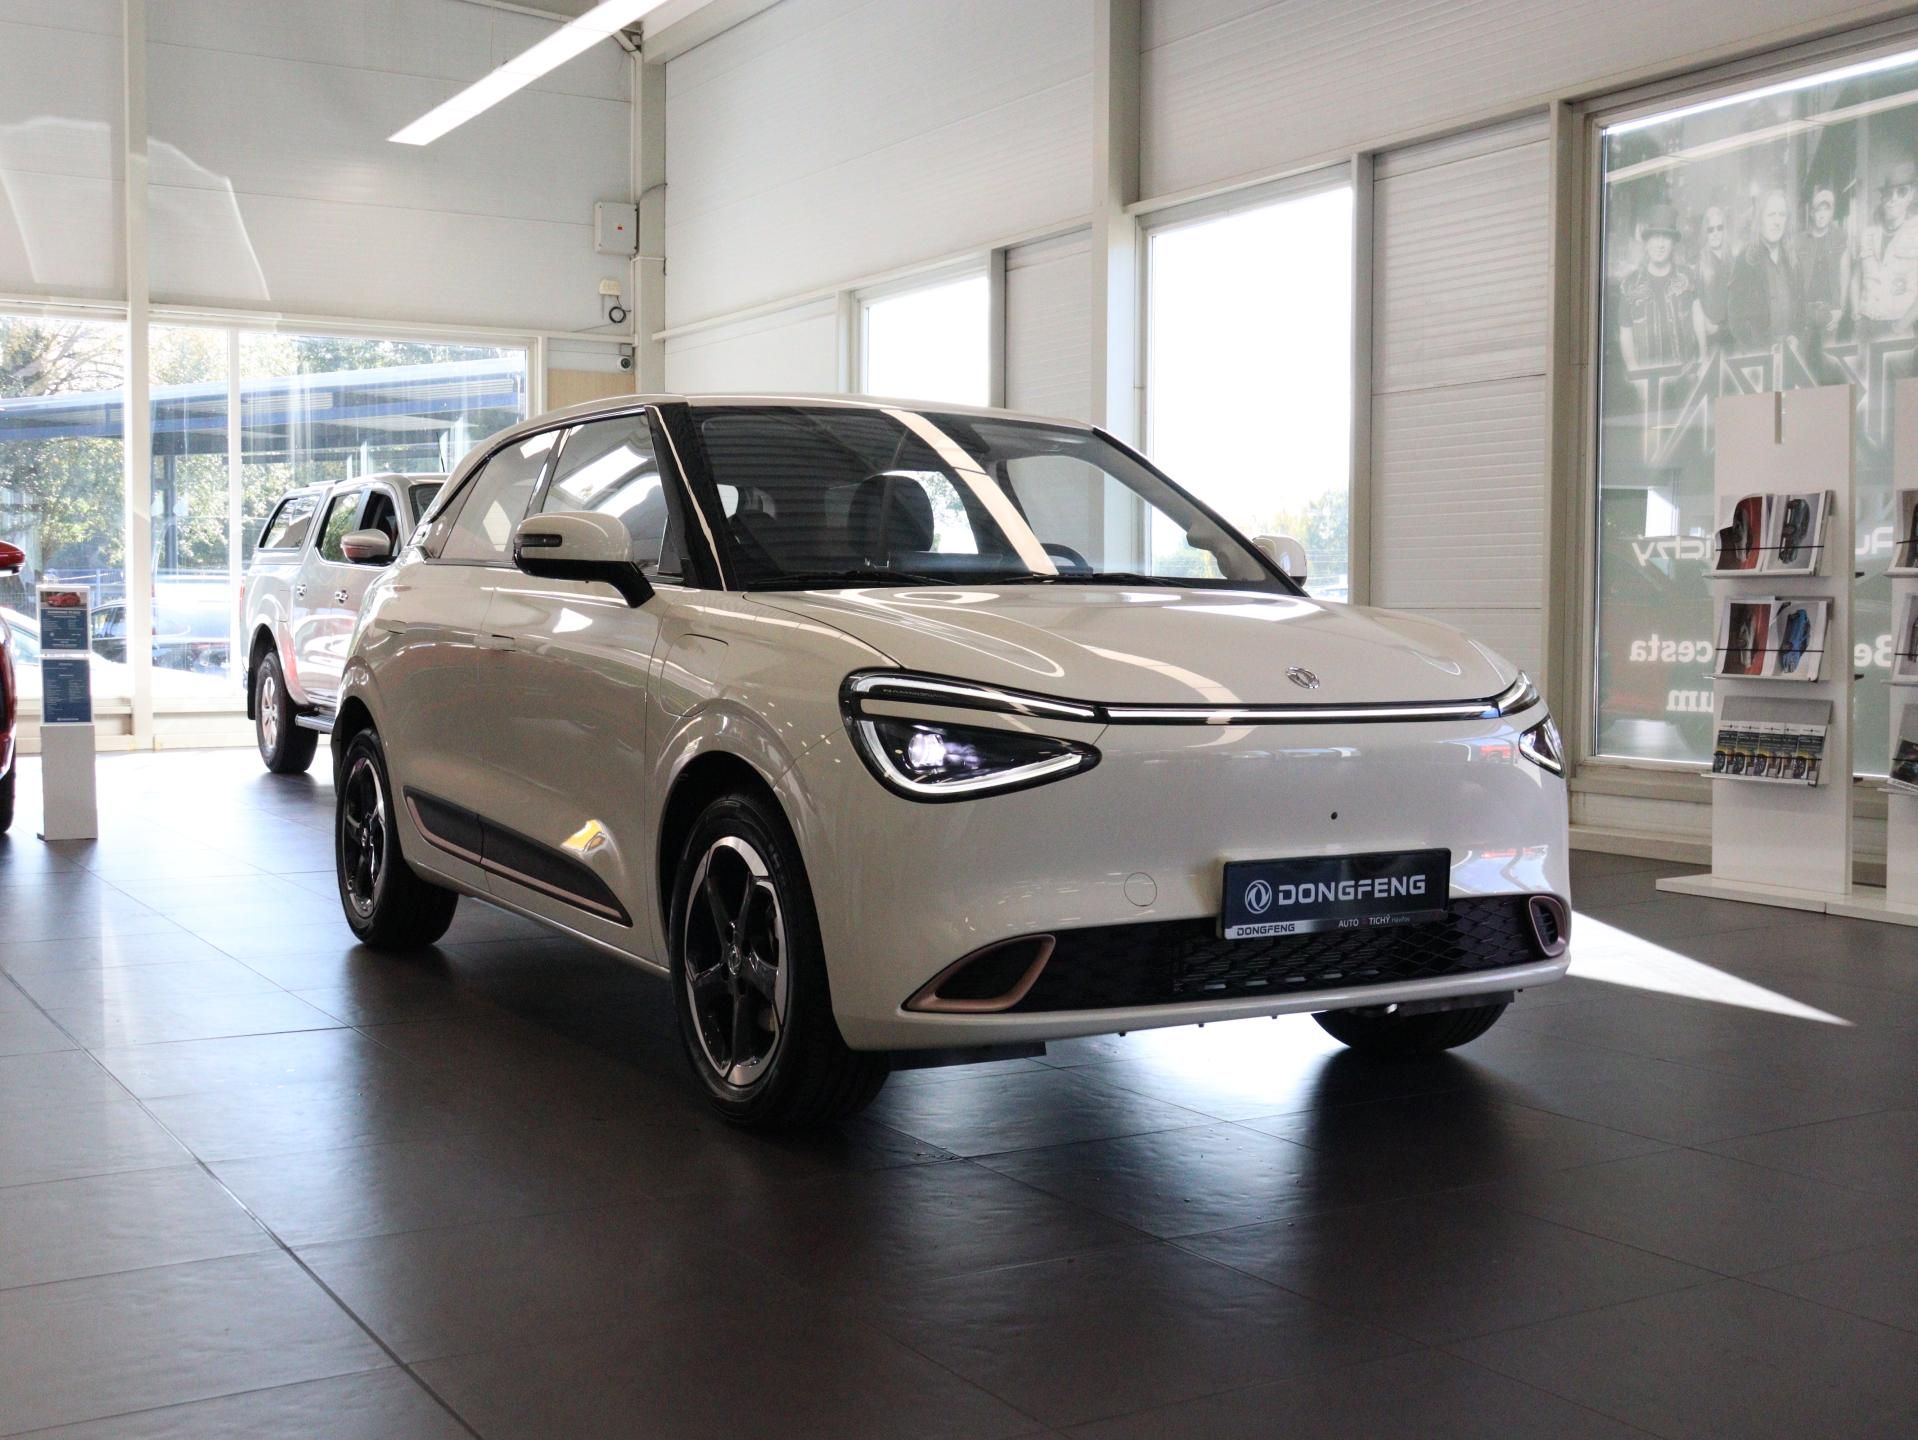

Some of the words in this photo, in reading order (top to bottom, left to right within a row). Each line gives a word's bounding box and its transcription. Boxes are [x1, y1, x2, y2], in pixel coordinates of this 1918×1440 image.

[1278, 874, 1426, 905] DONGFENG
[1236, 923, 1296, 936] DONGFENG
[1338, 918, 1359, 928] AUTO
